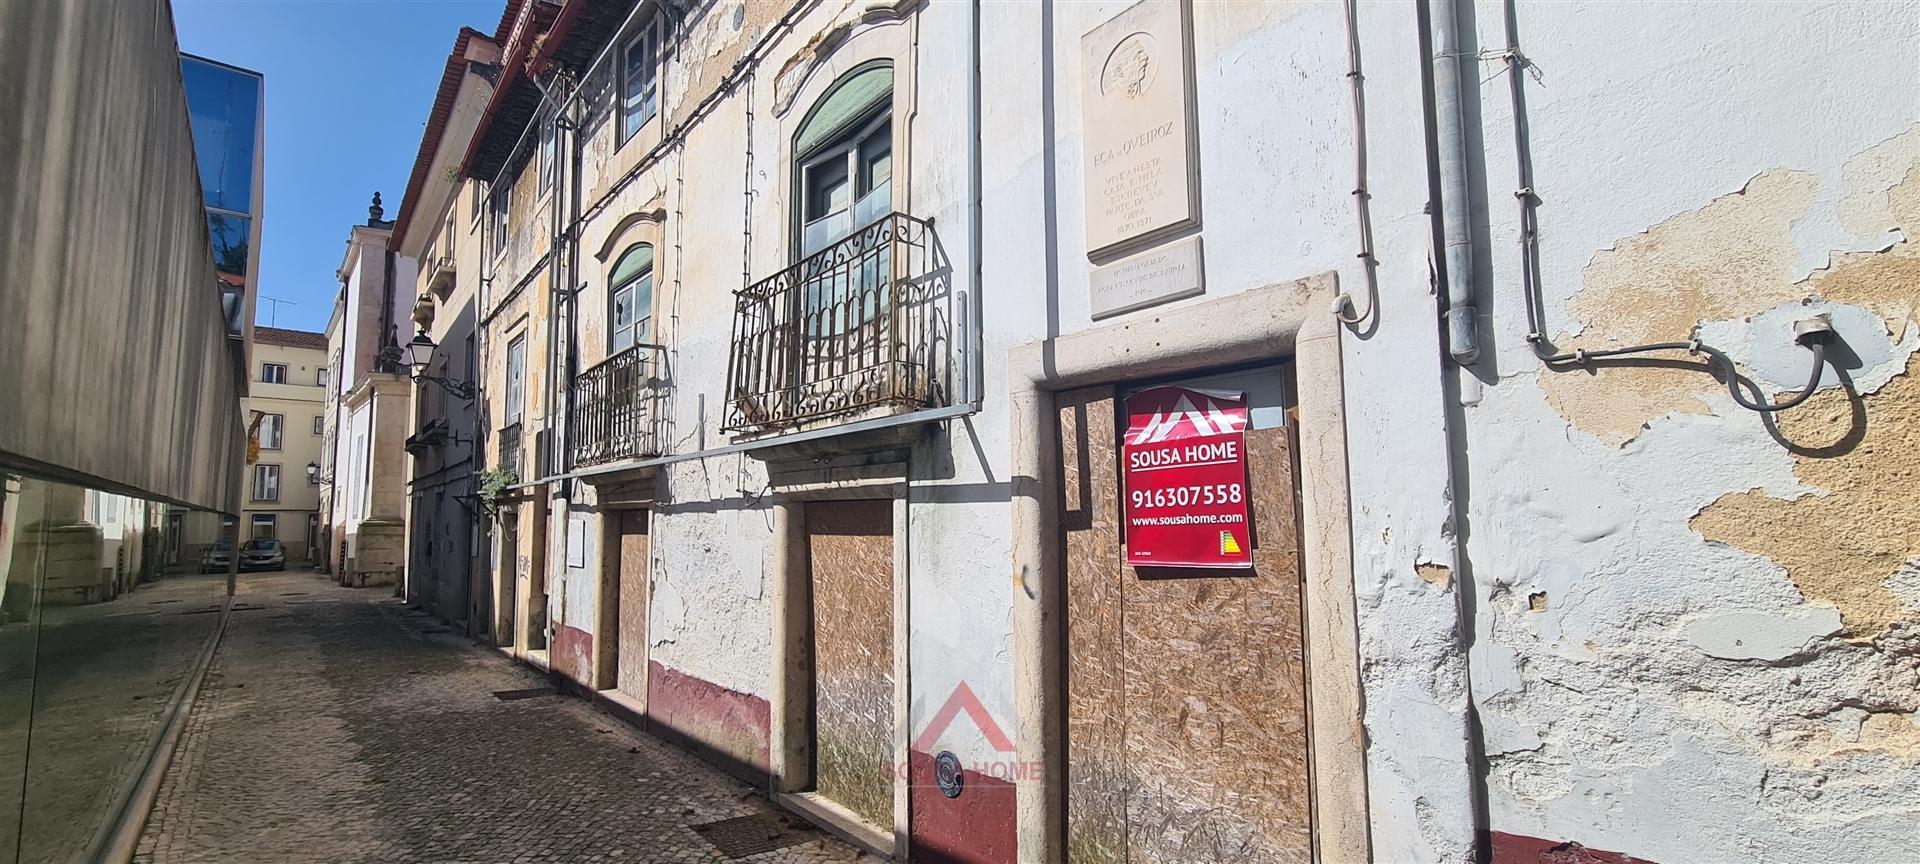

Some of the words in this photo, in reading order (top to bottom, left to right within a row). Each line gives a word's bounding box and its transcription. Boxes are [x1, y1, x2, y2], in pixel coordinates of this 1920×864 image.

[1130, 447, 1182, 468] SOUSA
[1185, 441, 1238, 462] HOME
[1132, 483, 1242, 508] 916307558
[1132, 513, 1243, 526] www.sousahome.com
